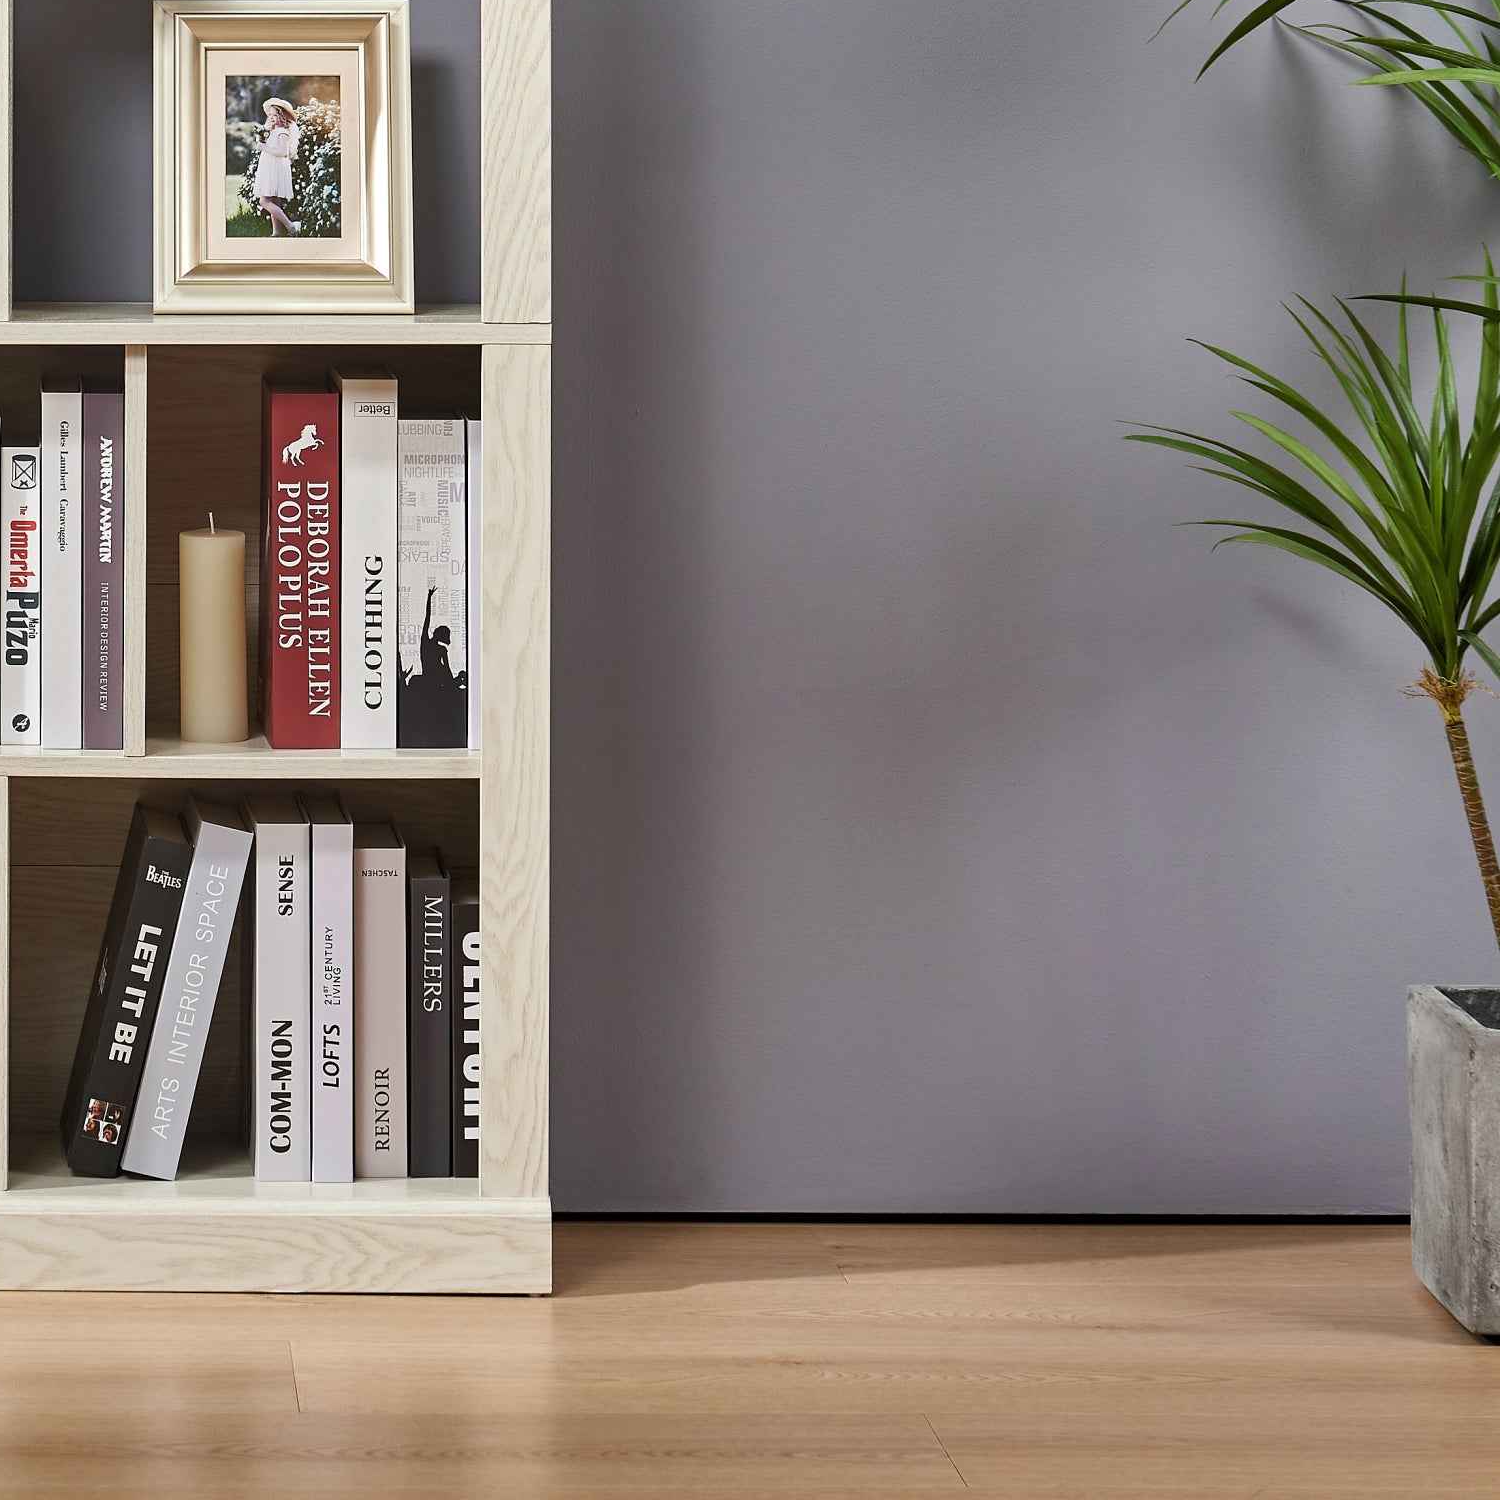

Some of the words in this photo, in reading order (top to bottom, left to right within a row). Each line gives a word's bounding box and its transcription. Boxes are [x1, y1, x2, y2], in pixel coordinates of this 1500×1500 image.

[59, 421, 69, 447] Gilles
[359, 405, 390, 414] Better
[59, 451, 69, 491] Lambert
[99, 436, 112, 504] ANDREW
[19, 505, 28, 516] The
[58, 499, 69, 552] Caravaggio
[98, 504, 112, 563] MARTIN
[277, 482, 302, 567] POLO
[10, 520, 37, 588] Omerta
[307, 482, 330, 617] DEBORAH
[6, 590, 39, 666] Puzo
[28, 618, 39, 639] Mario
[100, 582, 109, 629] INTERIOR
[278, 574, 302, 648] PLUS
[363, 556, 383, 709] CLOTHING
[99, 632, 109, 668] DESIGN
[307, 628, 330, 717] ELLEN
[99, 671, 108, 711] REVIEW
[142, 865, 181, 888] BEATLES
[277, 855, 293, 916] SENSE
[130, 924, 162, 981] LET
[325, 927, 333, 980] CENTURY
[423, 895, 442, 1012] MILLERS
[121, 987, 147, 1019] IT
[152, 1077, 180, 1141] ARTS
[167, 955, 208, 1065] INTERIOR
[196, 865, 229, 943] SPACE
[333, 967, 342, 1005] LIVING
[108, 1022, 137, 1065] BE
[323, 1024, 339, 1088] LOFTS
[270, 1020, 292, 1154] COM-MON
[374, 1068, 390, 1151] RENOIR
